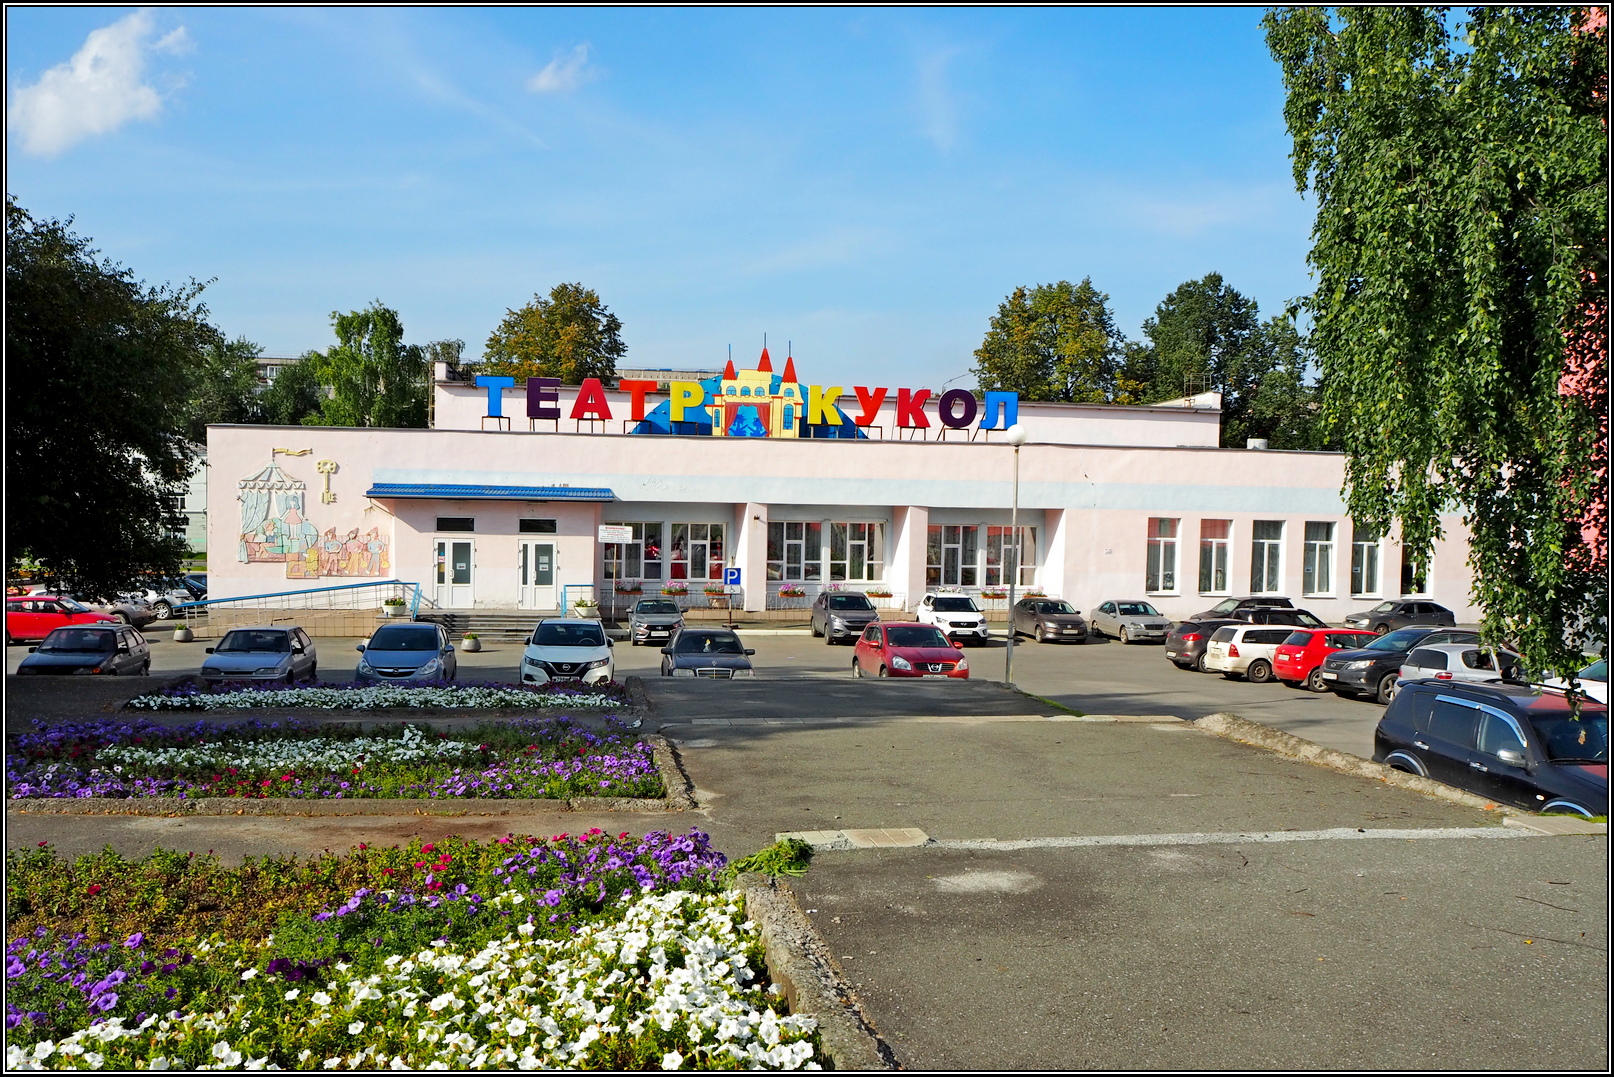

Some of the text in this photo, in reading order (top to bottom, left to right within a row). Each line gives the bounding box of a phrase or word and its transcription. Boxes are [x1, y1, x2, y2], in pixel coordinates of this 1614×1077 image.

[476, 375, 1019, 429] ТЕАТР КУКОЛ
[727, 569, 738, 584] P
